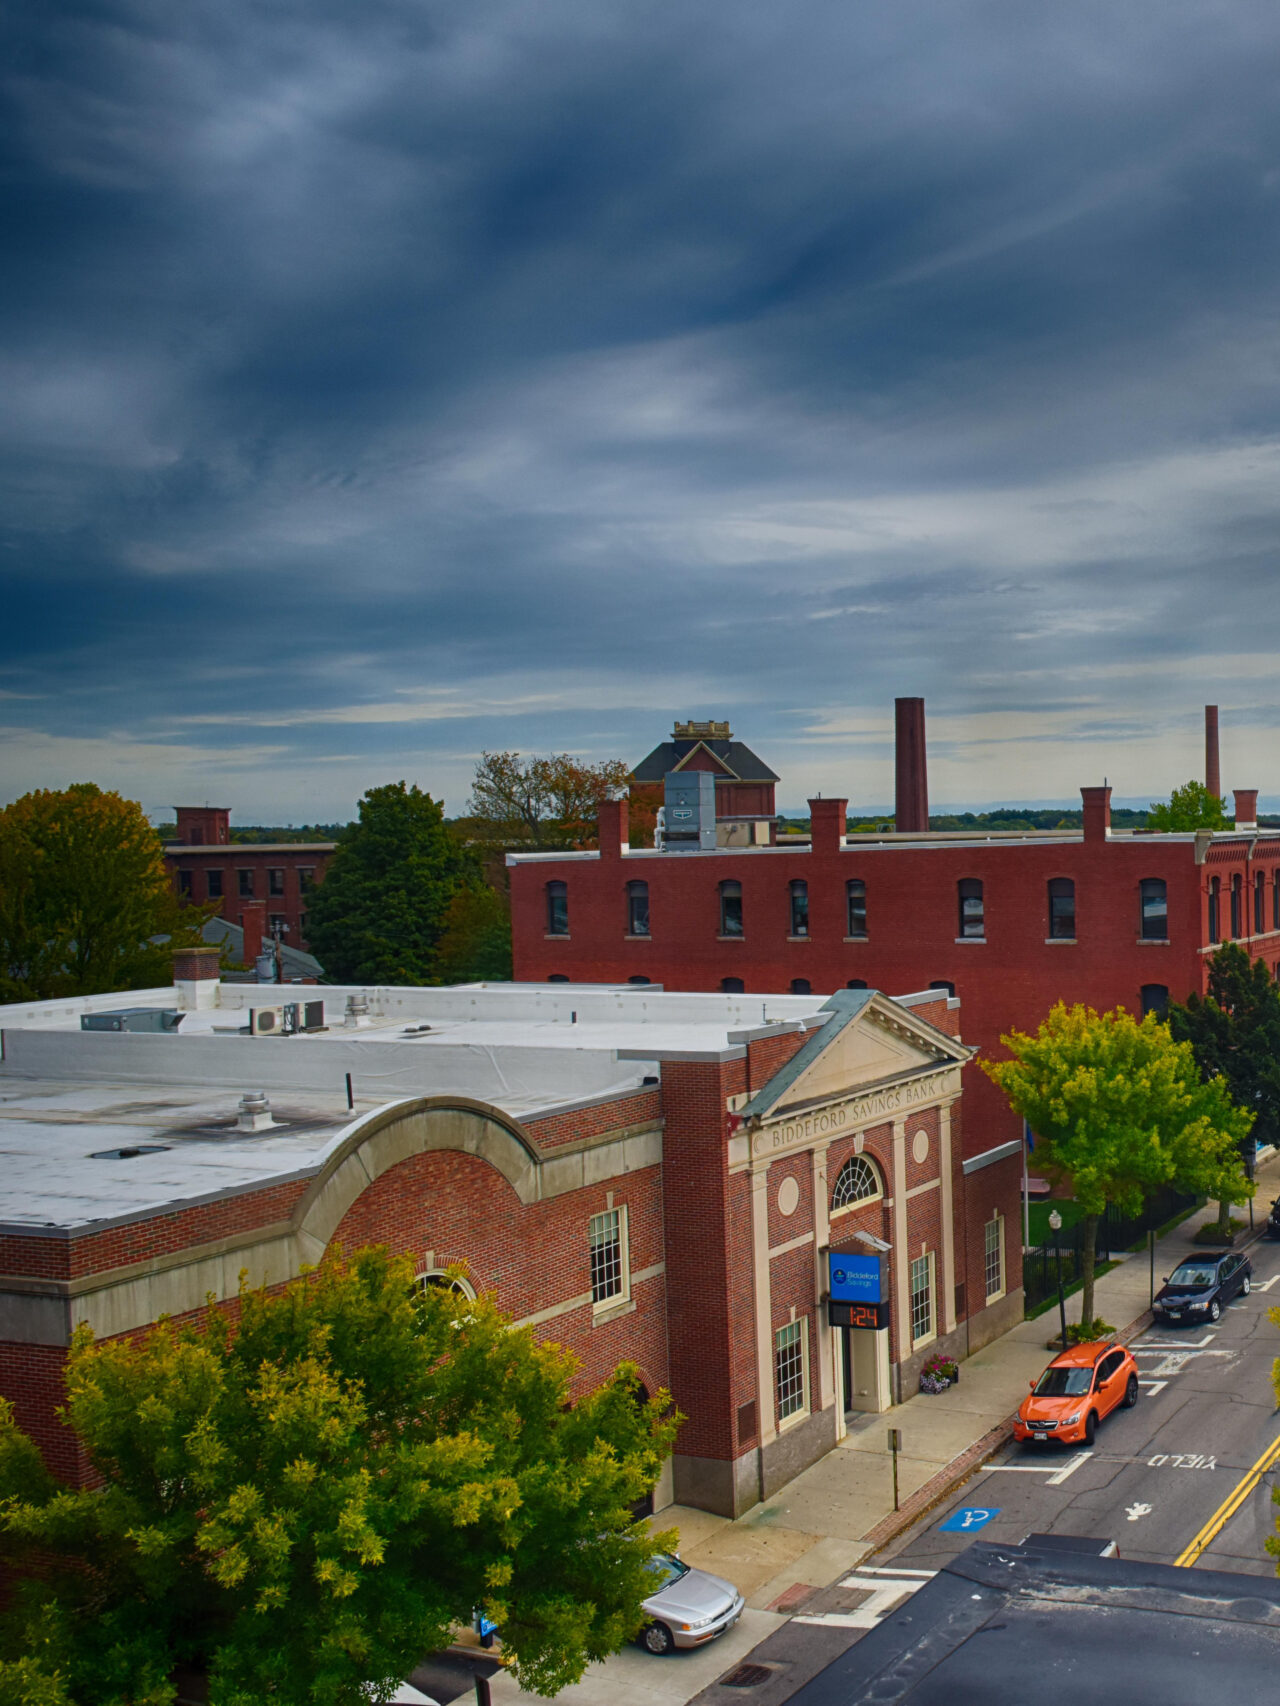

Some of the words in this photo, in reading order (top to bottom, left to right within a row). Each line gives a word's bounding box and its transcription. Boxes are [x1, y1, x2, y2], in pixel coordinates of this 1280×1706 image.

[772, 1109, 846, 1147] BIDDEFORD
[853, 1092, 901, 1121] SAVINGS
[906, 1082, 936, 1104] BANK
[847, 1271, 879, 1280] Biddeford
[849, 1306, 878, 1328] 1:24
[1147, 1454, 1217, 1470] YIELD
